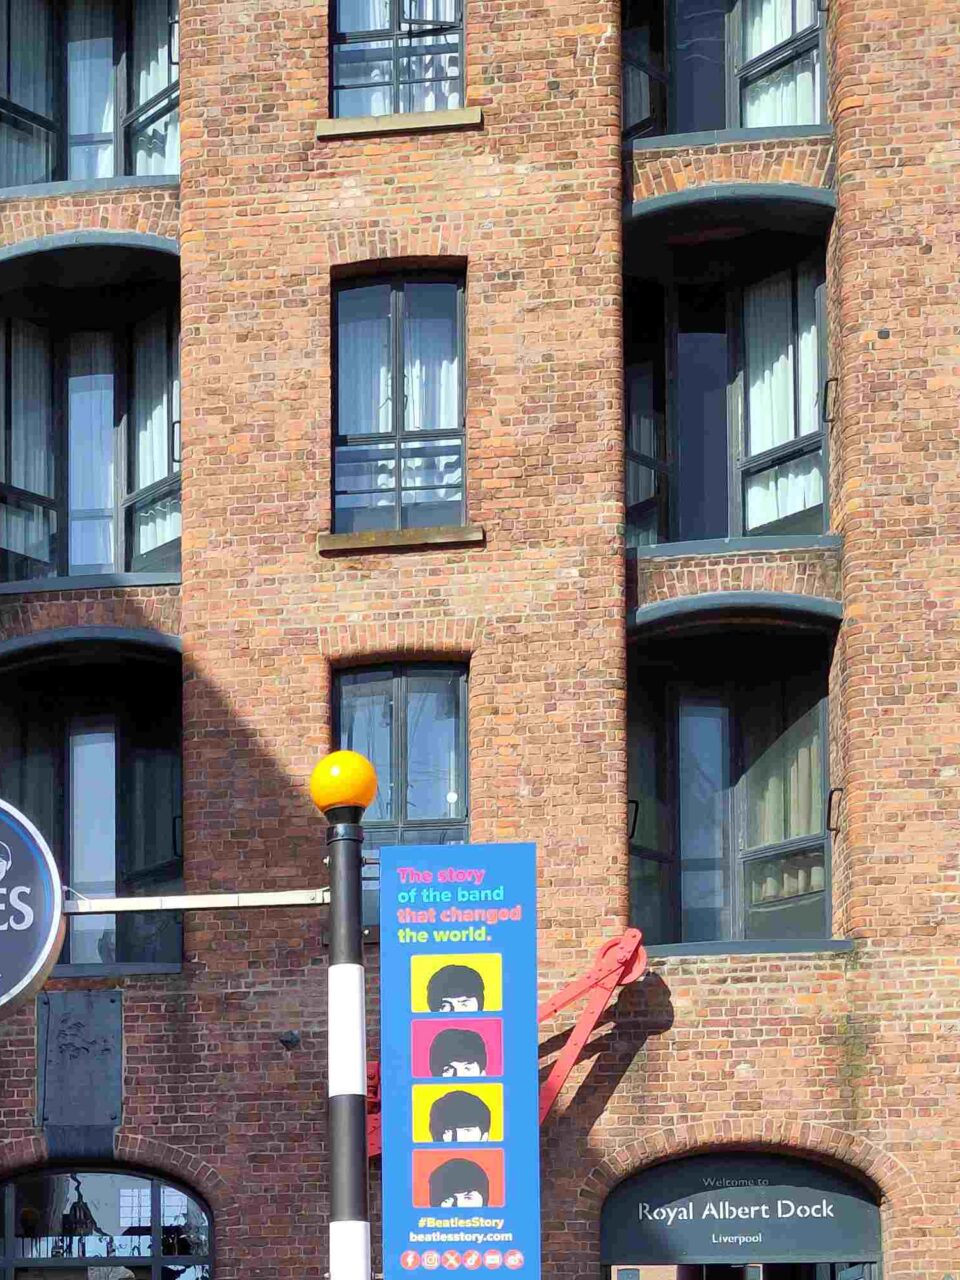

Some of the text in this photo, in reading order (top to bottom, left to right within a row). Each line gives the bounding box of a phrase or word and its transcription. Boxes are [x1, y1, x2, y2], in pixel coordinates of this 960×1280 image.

[397, 867, 486, 884] The story
[397, 886, 504, 903] of the band
[397, 905, 522, 925] that changed
[397, 926, 492, 943] the world.
[702, 1177, 769, 1187] Welcome to
[638, 1198, 835, 1225] Royal Albert Dock
[409, 1231, 513, 1244] beatlesstory.com
[712, 1232, 762, 1245] Liverpool
